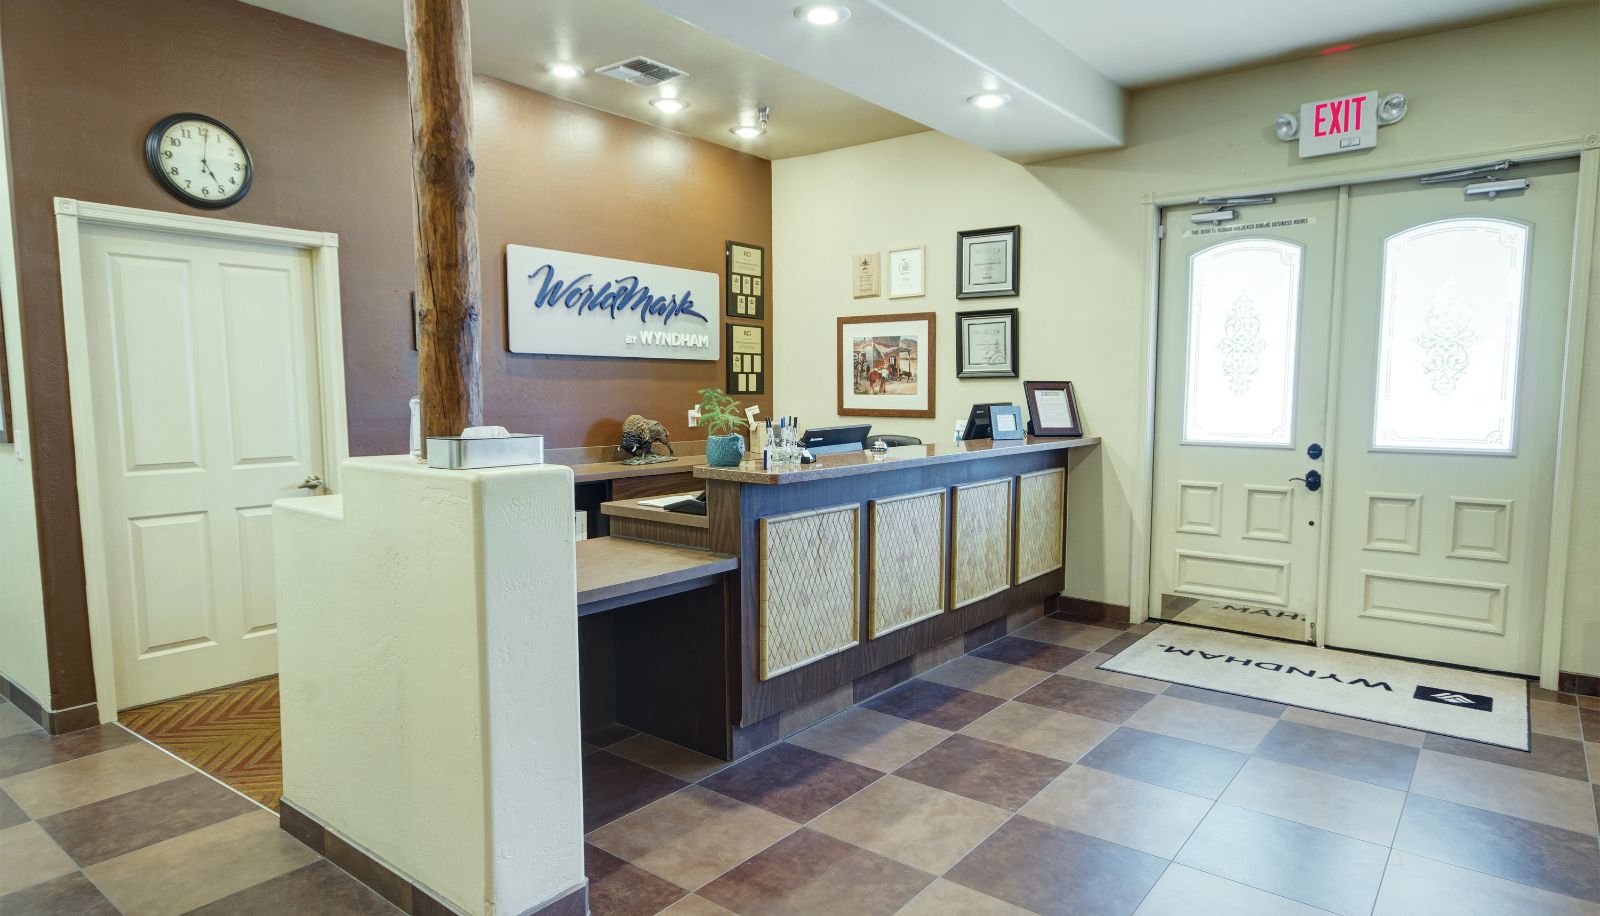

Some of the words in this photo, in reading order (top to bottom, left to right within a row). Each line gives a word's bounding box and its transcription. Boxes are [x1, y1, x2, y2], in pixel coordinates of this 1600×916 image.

[1314, 96, 1367, 137] EXIT
[182, 129, 191, 139] 11
[198, 127, 209, 137] 12
[170, 137, 181, 147] 10
[217, 134, 221, 143] 1
[164, 151, 173, 159] 9
[228, 148, 235, 156] 2
[171, 167, 179, 176] 8
[234, 163, 241, 171] 3
[184, 180, 191, 189] 7
[229, 177, 236, 185] 4
[202, 186, 209, 195] 6
[218, 185, 225, 193] 5
[1234, 223, 1255, 231] UNLOCKED
[1272, 219, 1293, 227] BUSINESS
[528, 264, 708, 325] WorldMark
[626, 335, 637, 344] BY
[640, 331, 709, 348] WYNDHAM
